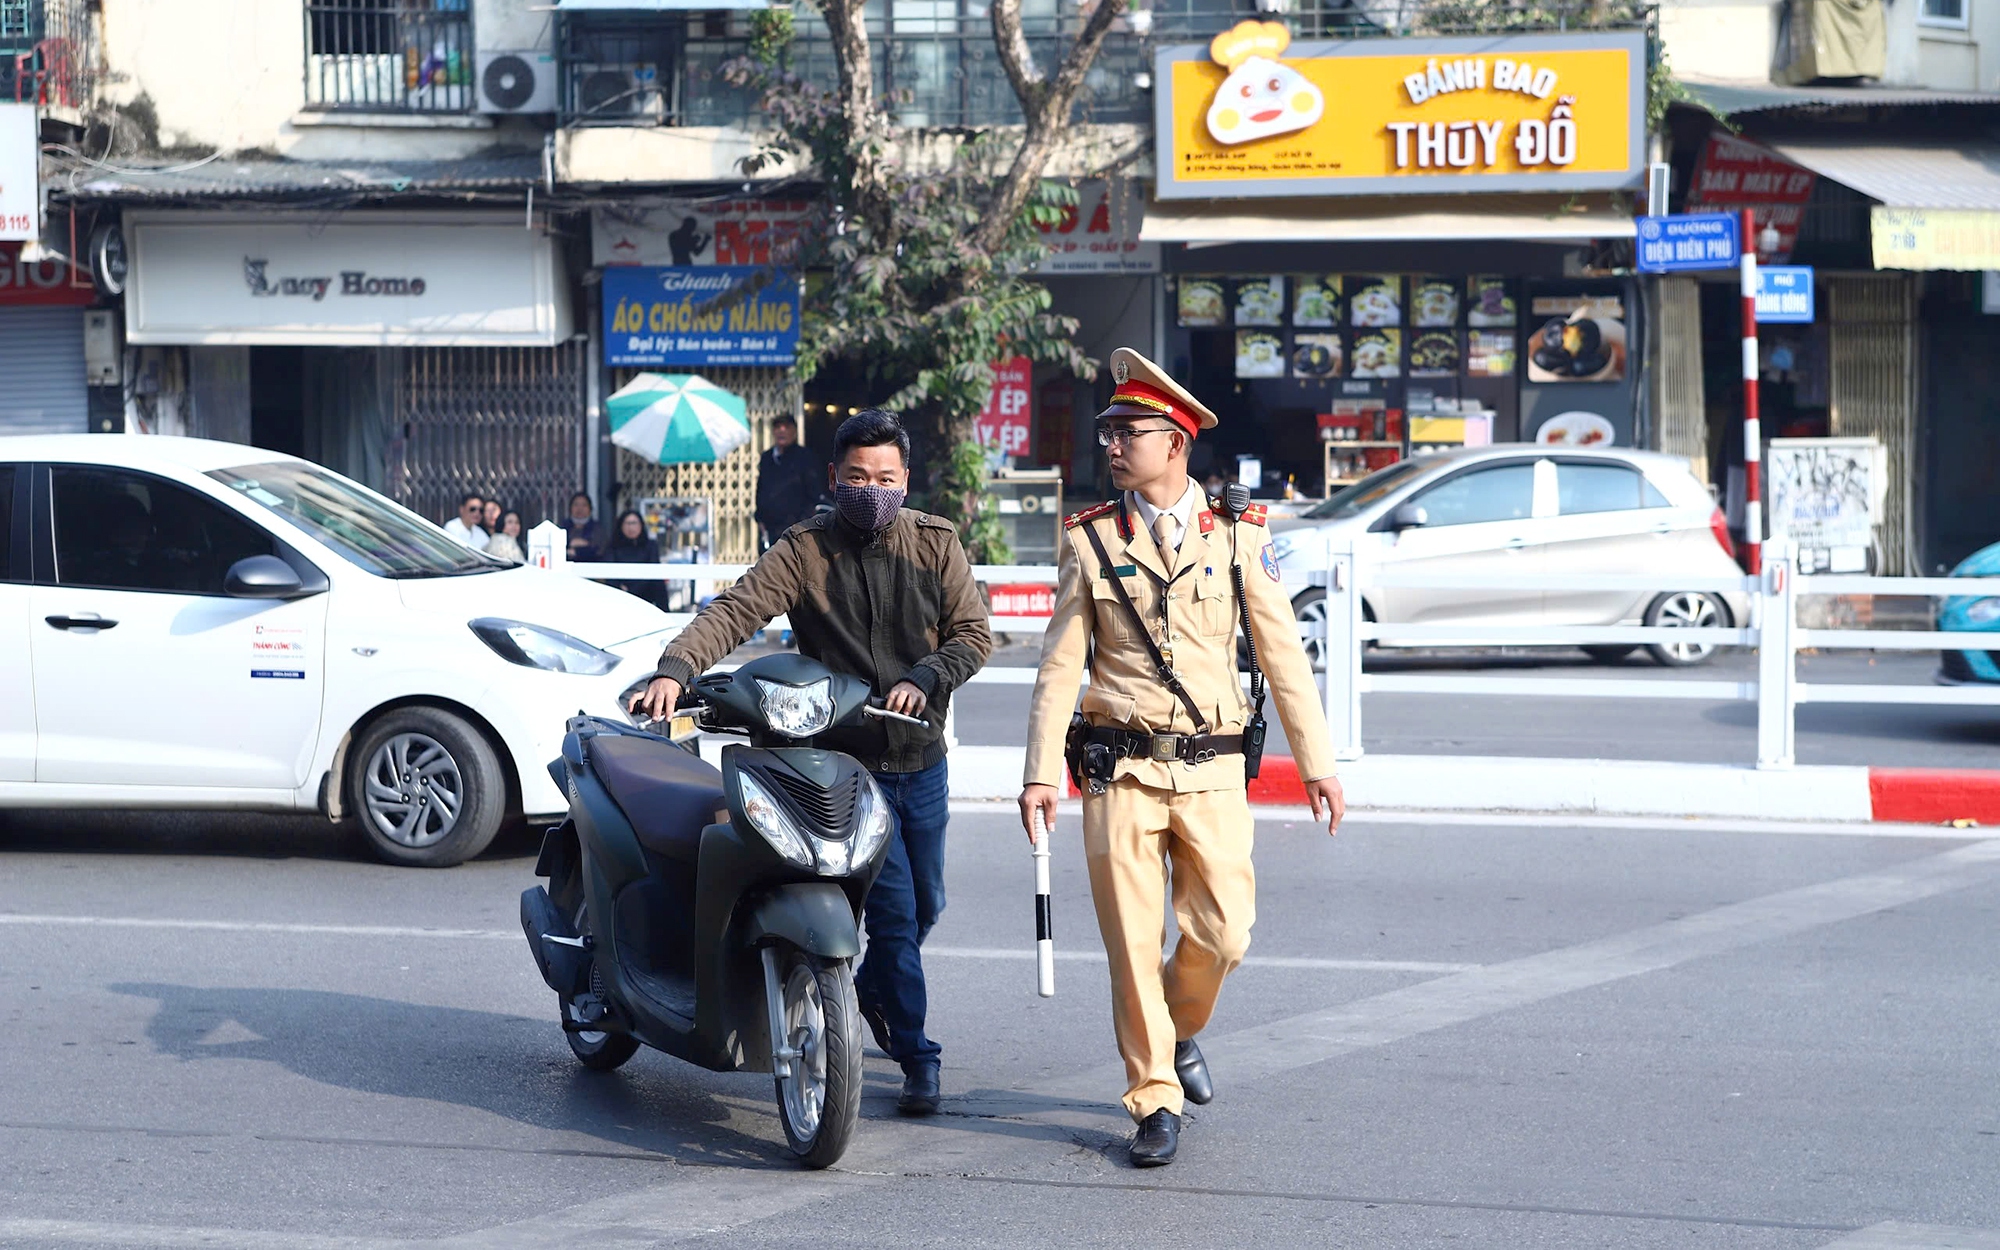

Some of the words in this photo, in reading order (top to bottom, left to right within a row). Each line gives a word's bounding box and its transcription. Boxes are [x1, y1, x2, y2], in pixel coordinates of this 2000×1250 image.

[1404, 58, 1485, 105] BÁNH
[1493, 59, 1558, 99] BAO
[1515, 95, 1577, 166] ĐỖ
[243, 254, 332, 302] Lucy
[340, 270, 426, 297] Home
[659, 272, 732, 292] Thanh
[612, 296, 644, 333] ÁO
[999, 385, 1028, 415] ÉP
[999, 420, 1028, 451] ÉP
